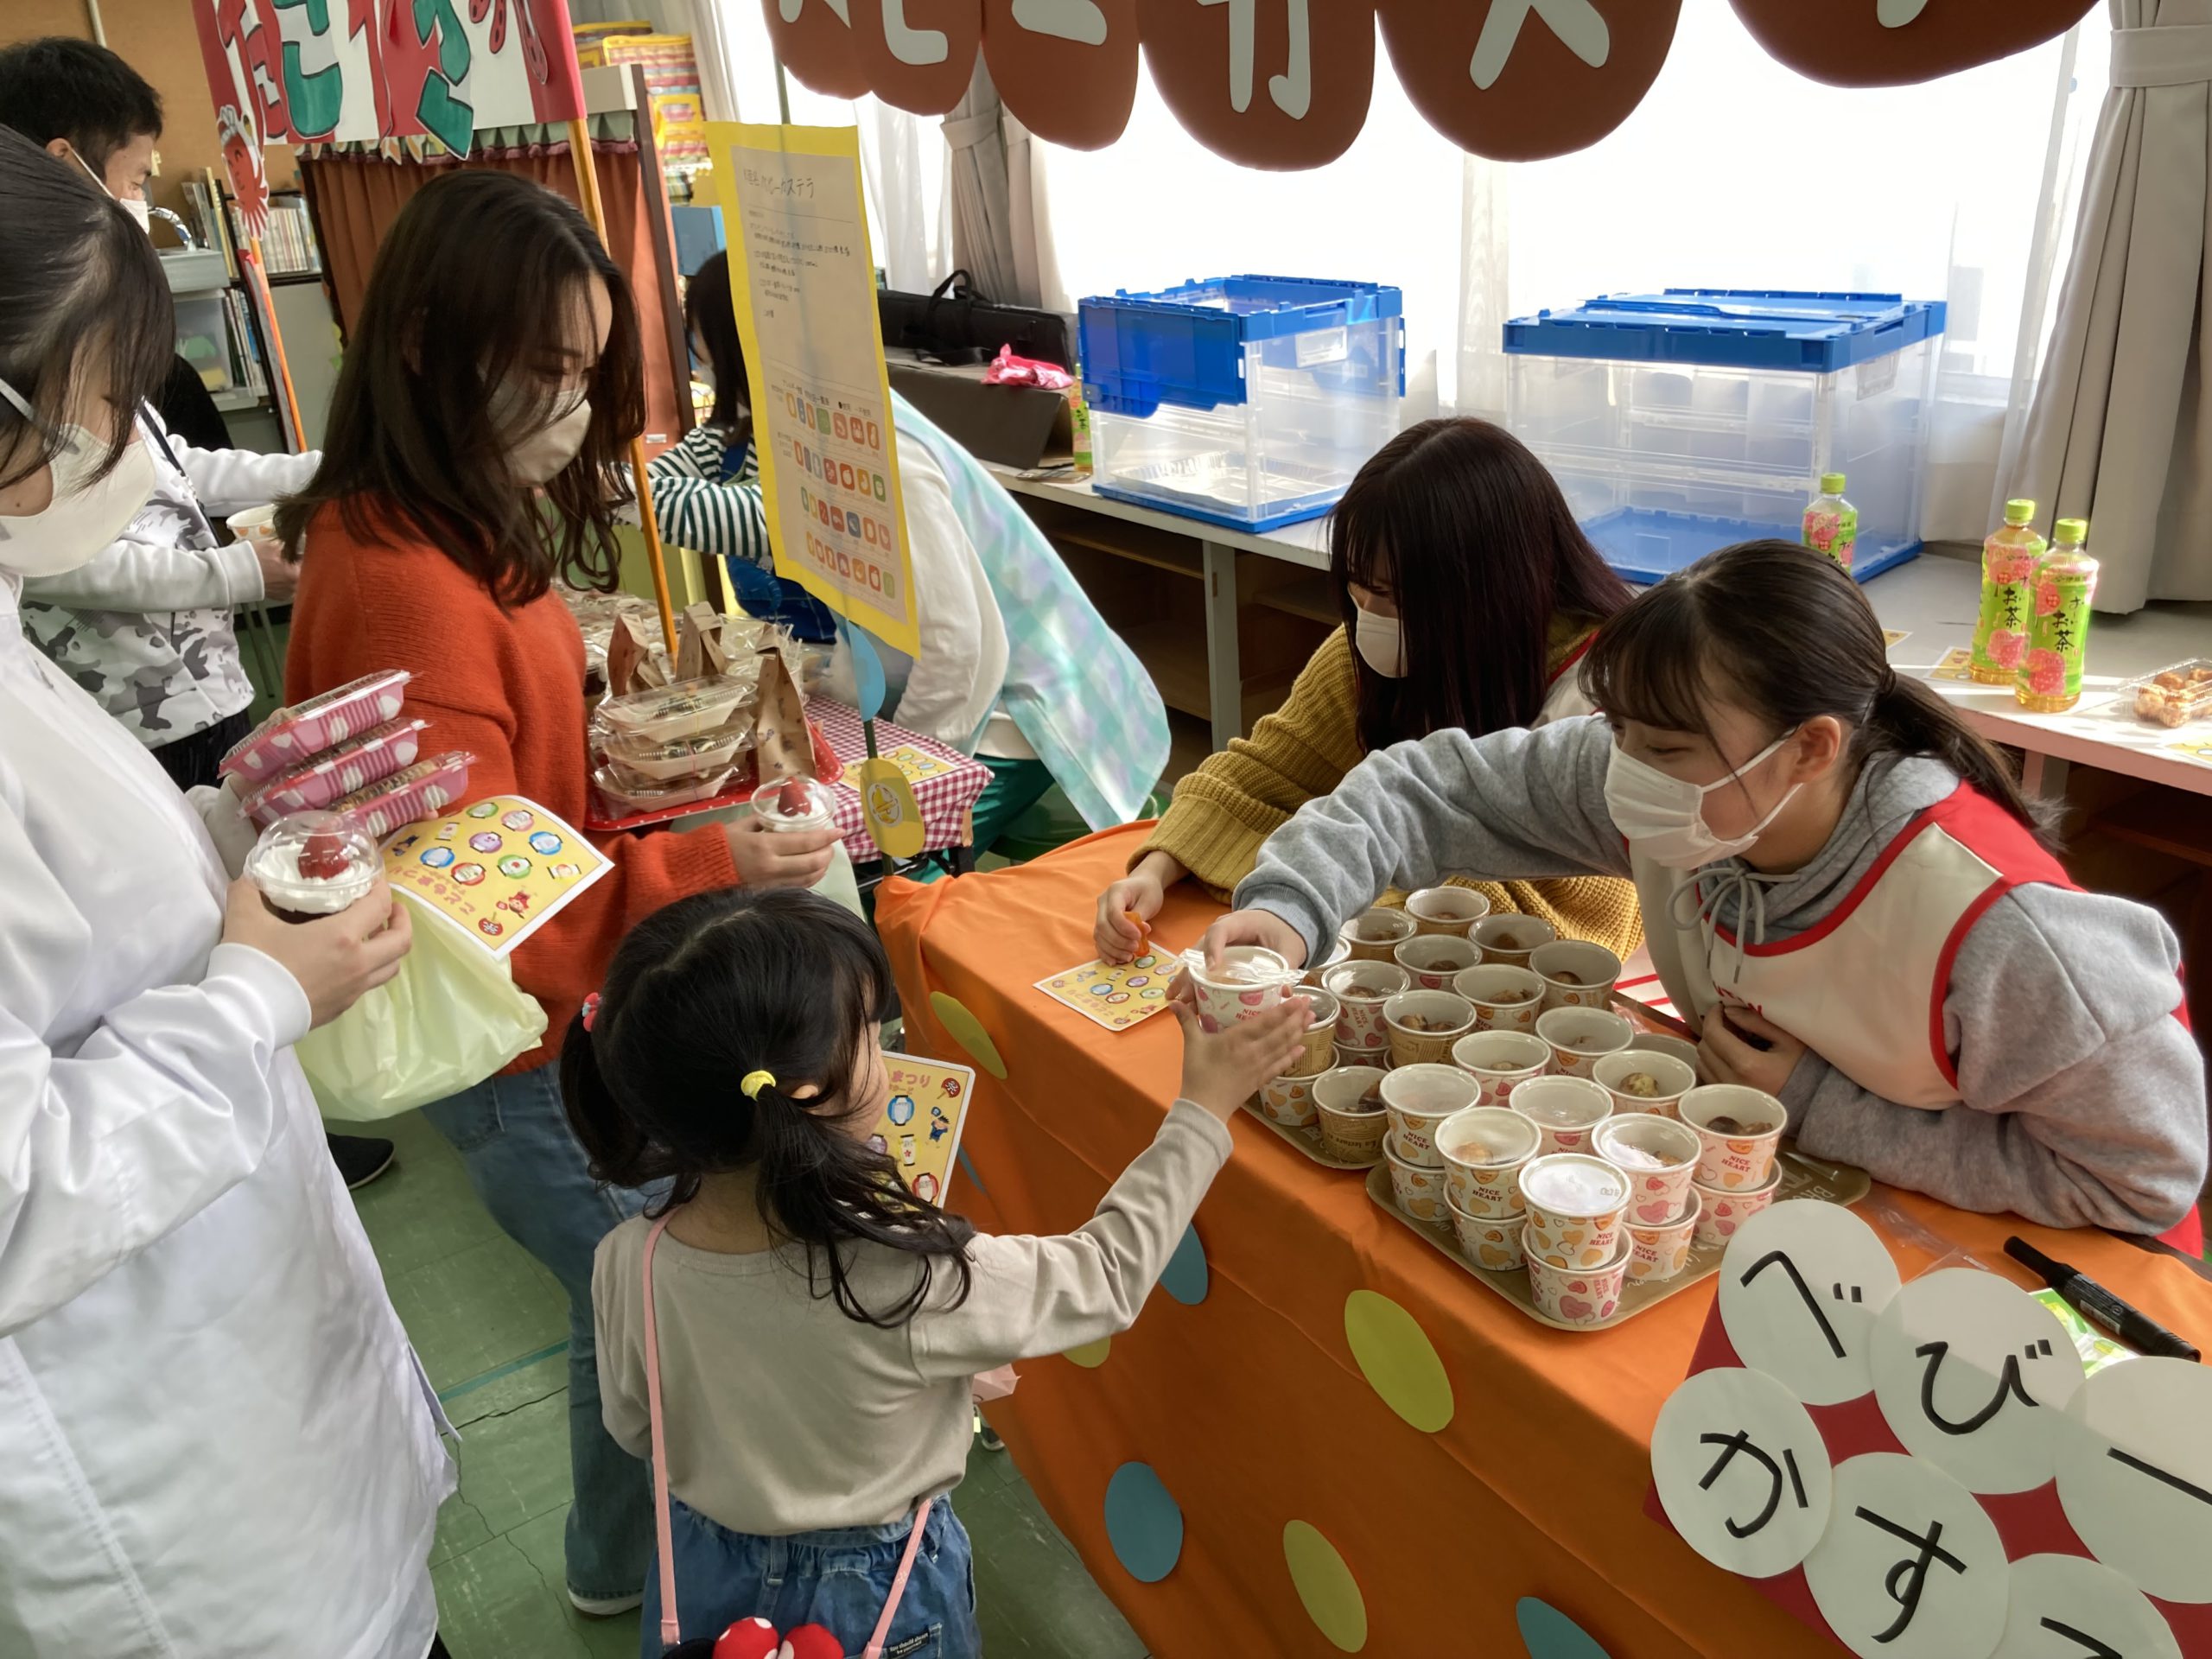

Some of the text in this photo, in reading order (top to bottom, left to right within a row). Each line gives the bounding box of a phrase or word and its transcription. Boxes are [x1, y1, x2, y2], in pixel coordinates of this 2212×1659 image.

[2002, 587, 2022, 629] お茶
[2051, 609, 2075, 652] お茶
[1402, 1134, 1431, 1151] HEART
[1408, 1131, 1429, 1145] NICE
[1721, 1159, 1752, 1173] HEART
[1728, 1155, 1751, 1166] NICE
[1471, 1190, 1503, 1203] HEART
[1478, 1186, 1501, 1197] NICE
[1635, 1245, 1657, 1255] NICE
